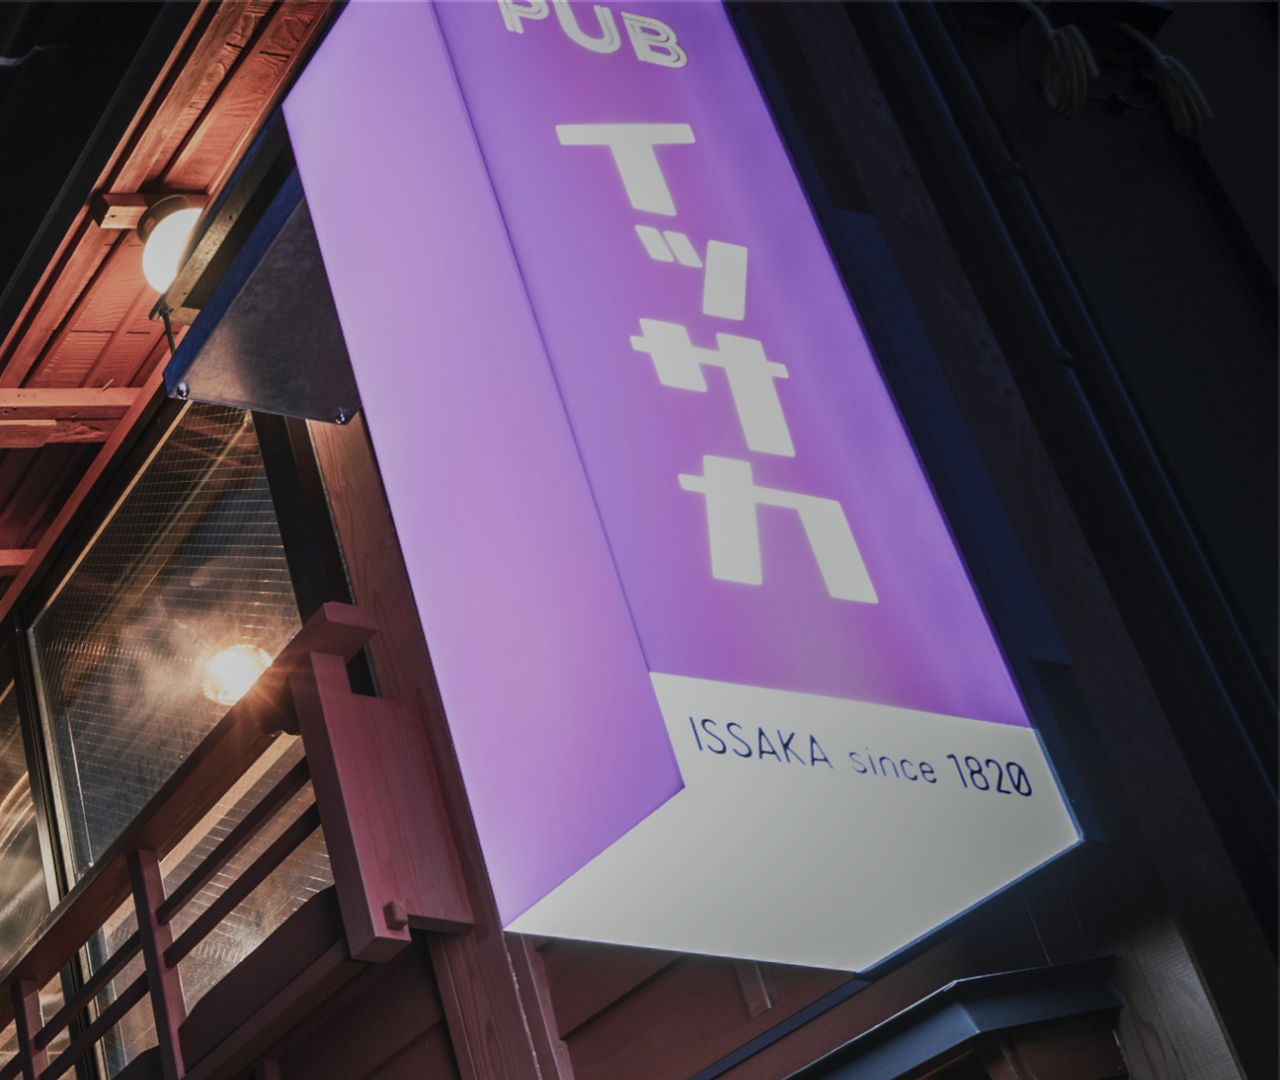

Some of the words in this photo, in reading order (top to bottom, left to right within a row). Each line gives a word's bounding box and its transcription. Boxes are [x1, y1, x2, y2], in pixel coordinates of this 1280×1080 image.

[497, 0, 688, 68] PUB
[555, 124, 879, 604] イッサカ
[689, 716, 834, 770] ISSAKA
[849, 747, 937, 784] since
[947, 754, 1033, 798] 1820
